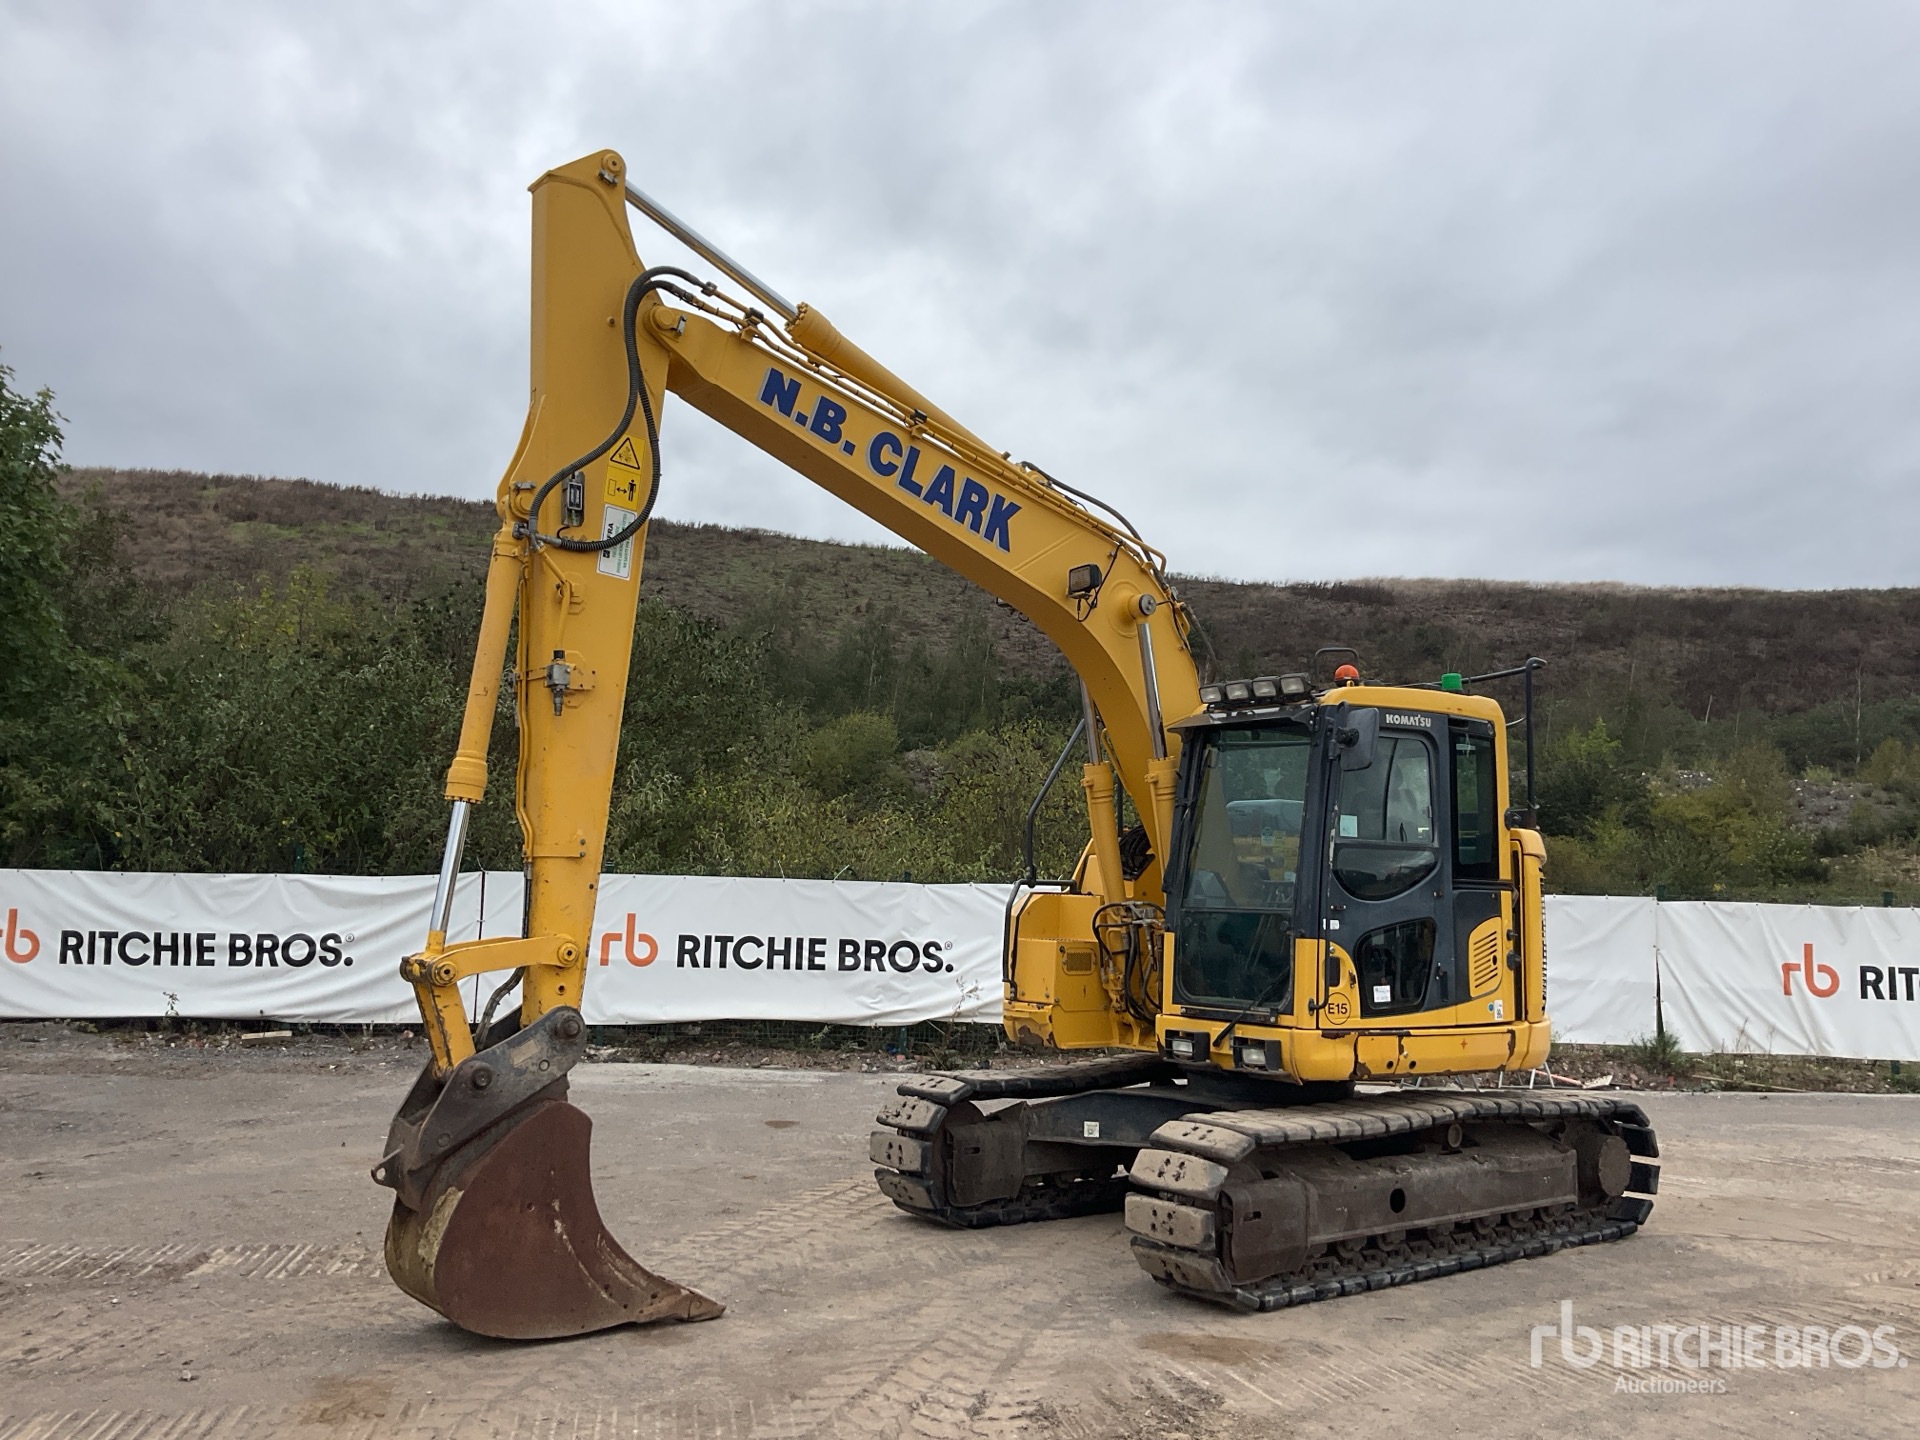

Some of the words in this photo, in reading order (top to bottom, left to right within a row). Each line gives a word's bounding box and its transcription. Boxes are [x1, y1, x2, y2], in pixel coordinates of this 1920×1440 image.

[758, 367, 855, 456] N.B.
[866, 431, 1022, 553] CLARK
[1385, 713, 1431, 727] KOMATSU
[0, 908, 40, 963] b
[59, 930, 216, 967] RITCHIE
[227, 932, 354, 967] BROS.
[599, 913, 659, 967] rb
[676, 934, 827, 971] RITCHIE
[838, 938, 954, 974] BROS.
[1781, 943, 1840, 998] rb
[1860, 965, 1920, 1001] RIT
[1327, 1003, 1348, 1015] E15
